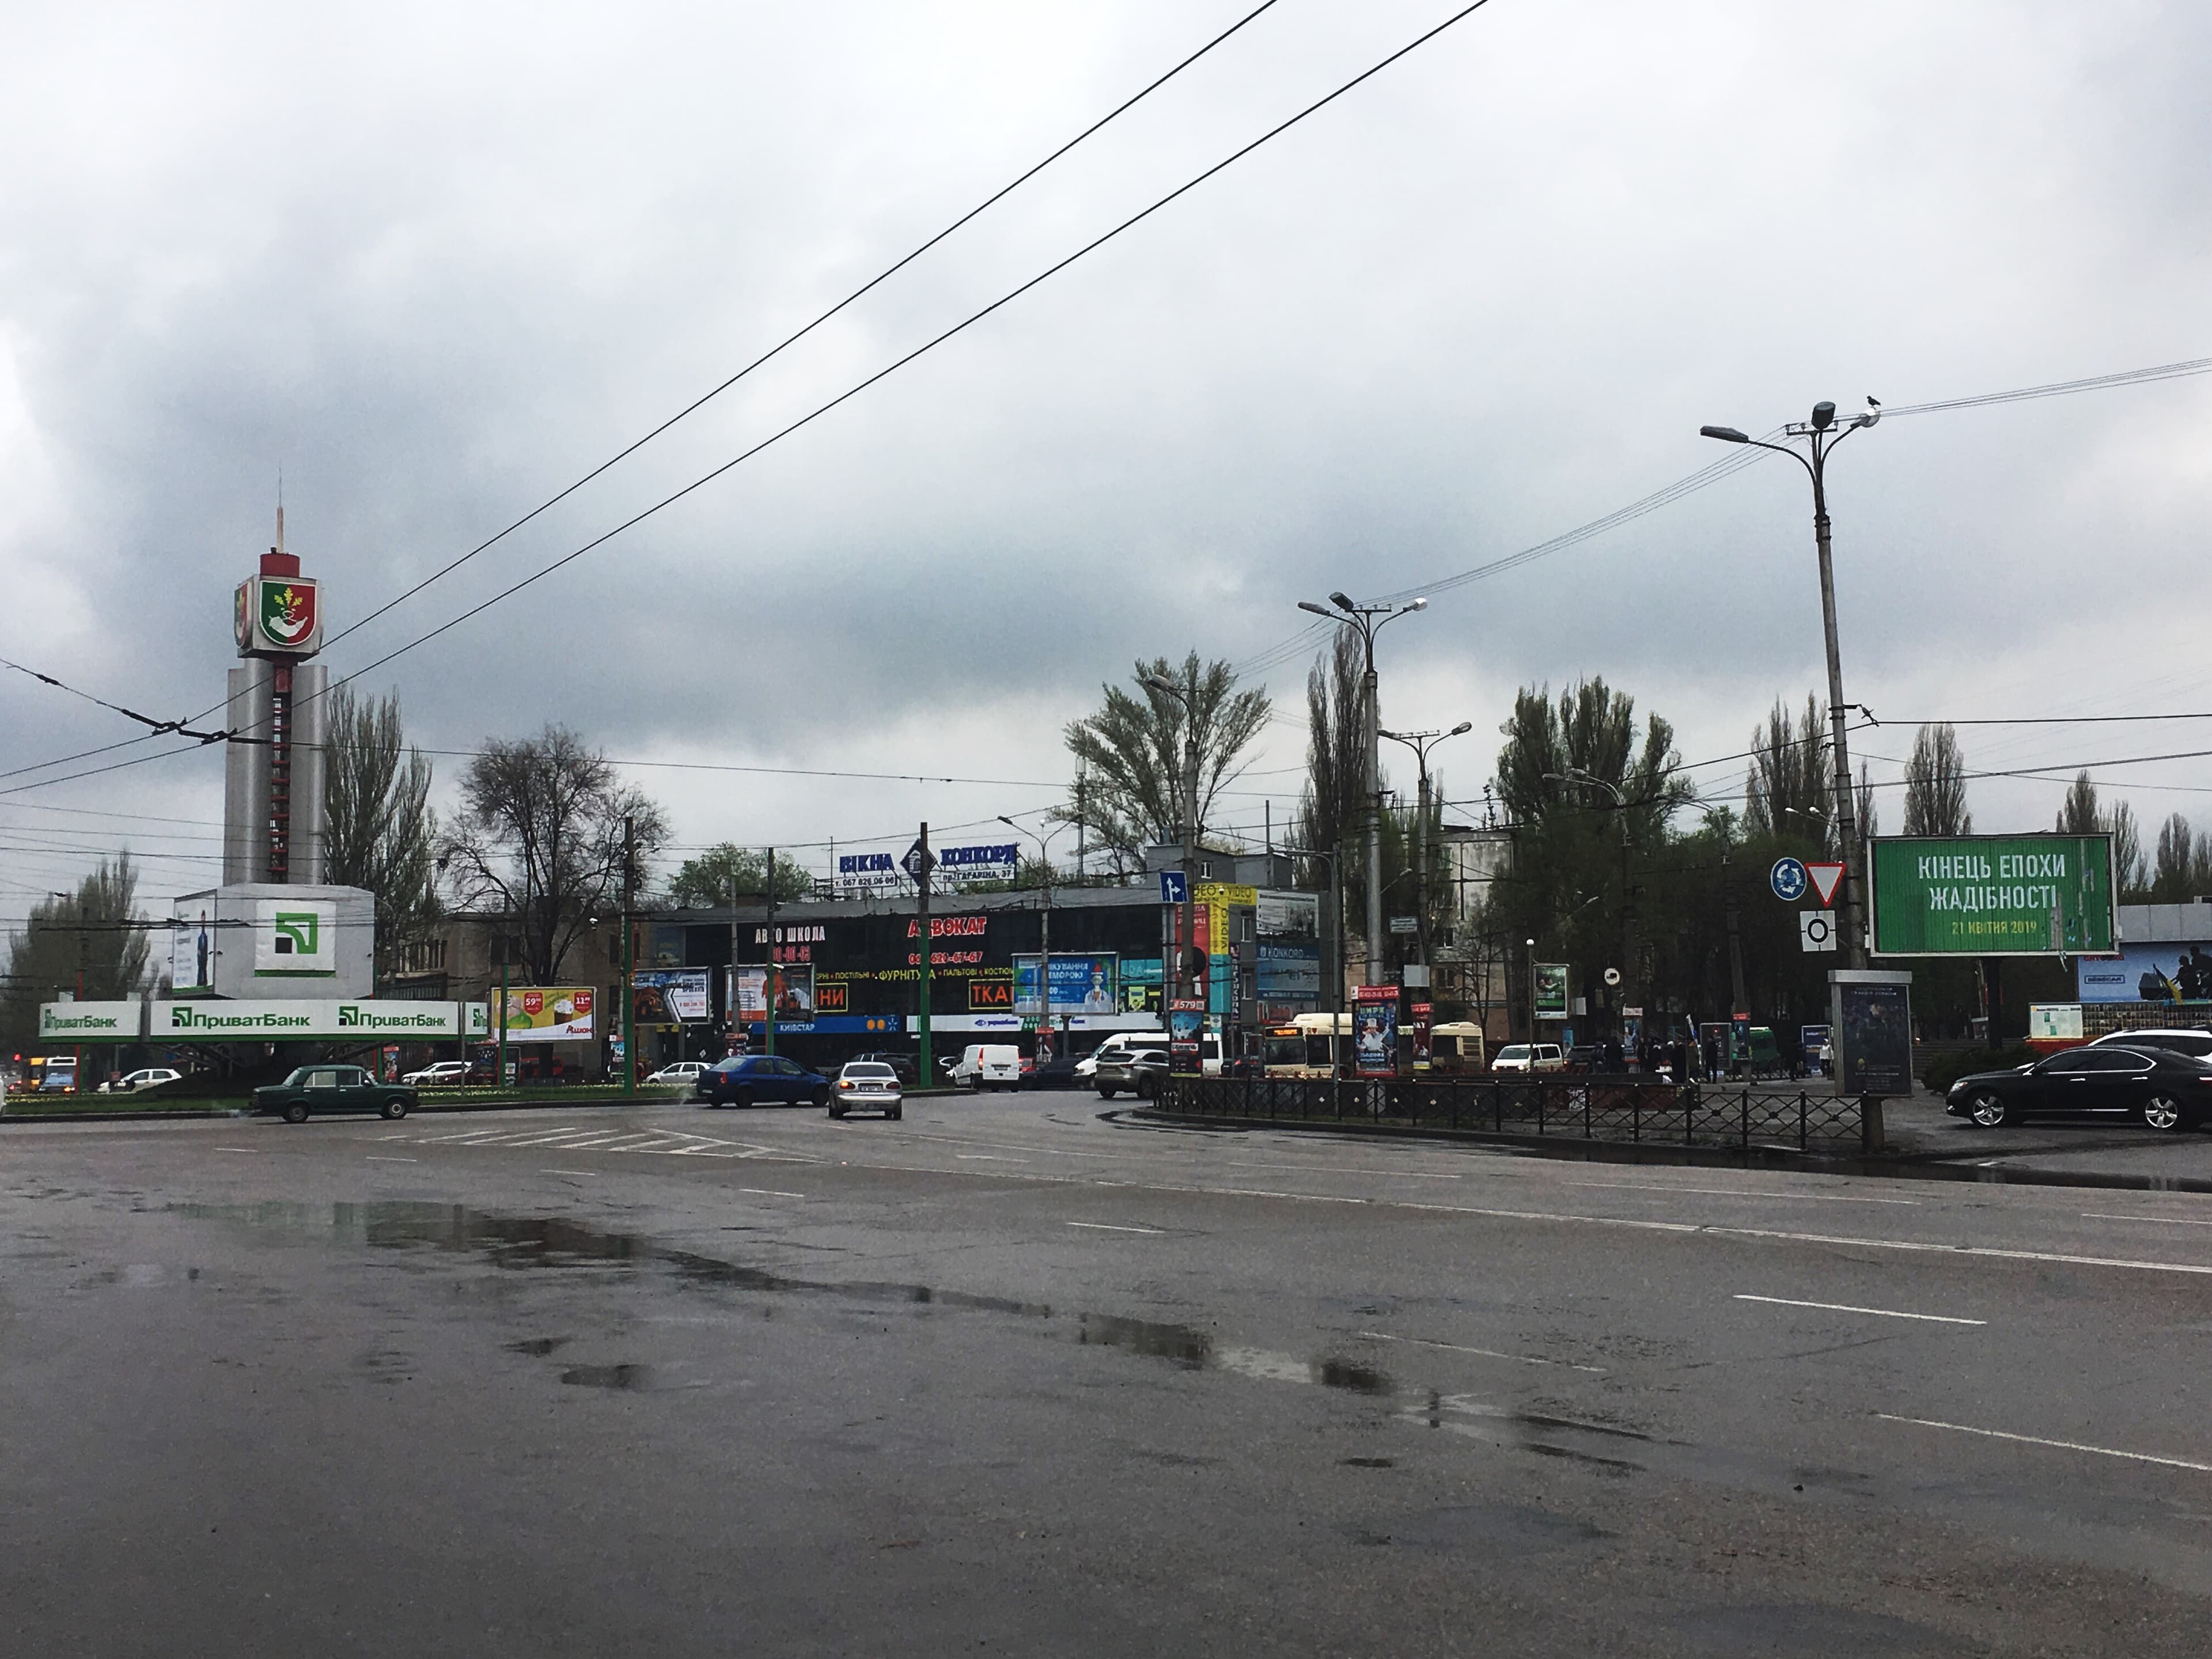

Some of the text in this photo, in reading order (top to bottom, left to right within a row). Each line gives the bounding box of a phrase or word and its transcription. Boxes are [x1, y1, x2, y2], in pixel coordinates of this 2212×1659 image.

[839, 853, 895, 872] ВІКНА
[940, 844, 1016, 865] КОНКОРД
[1918, 854, 2066, 881] КІНЕЦЬ ЕПОХИ
[1228, 887, 1252, 898] VIDEO
[1929, 885, 2057, 913] ЖАДІБНОСТІ
[755, 926, 825, 944] АВО ШКОЛА
[1952, 921, 2037, 934] 21 КВІТНЯ 2019
[1268, 948, 1304, 959] KONKORD
[879, 968, 935, 981] ФУРНІТУА
[943, 968, 978, 976] ПАЛЬТОВІ
[1179, 1001, 1196, 1009] 579
[194, 1013, 311, 1030] ПриватБанк
[359, 1013, 446, 1029] ПриватБанк
